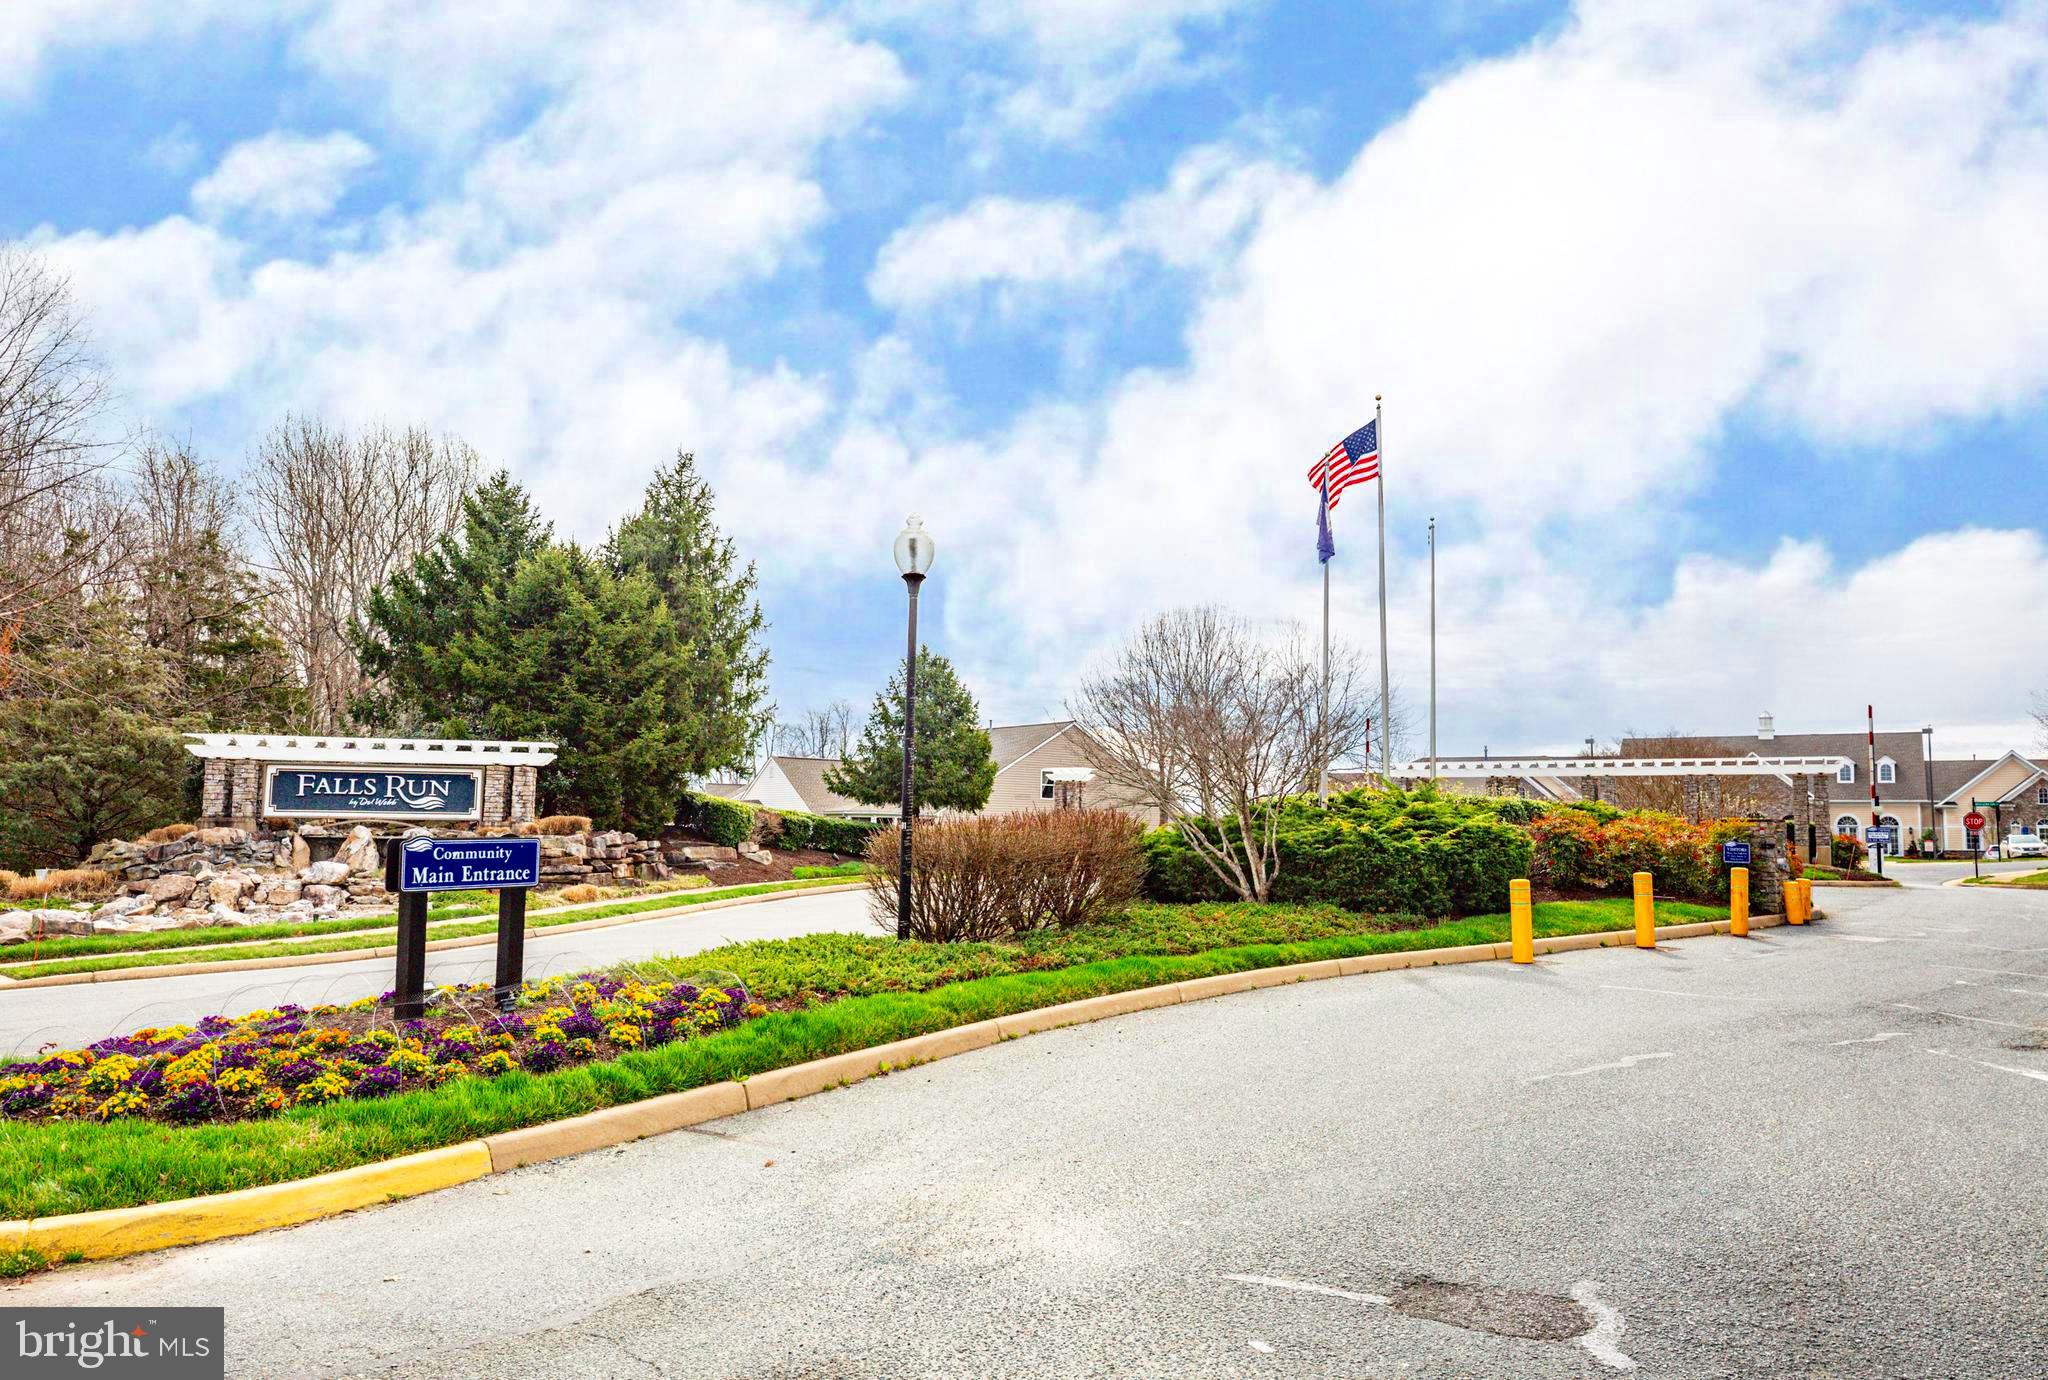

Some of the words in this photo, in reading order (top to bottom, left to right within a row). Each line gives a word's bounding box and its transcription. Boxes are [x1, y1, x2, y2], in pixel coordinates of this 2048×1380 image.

[296, 774, 377, 796] FALLS
[384, 775, 452, 799] RUN
[349, 798, 358, 808] by
[433, 845, 512, 862] Community
[412, 866, 454, 884] Main
[461, 865, 530, 882] Entrance
